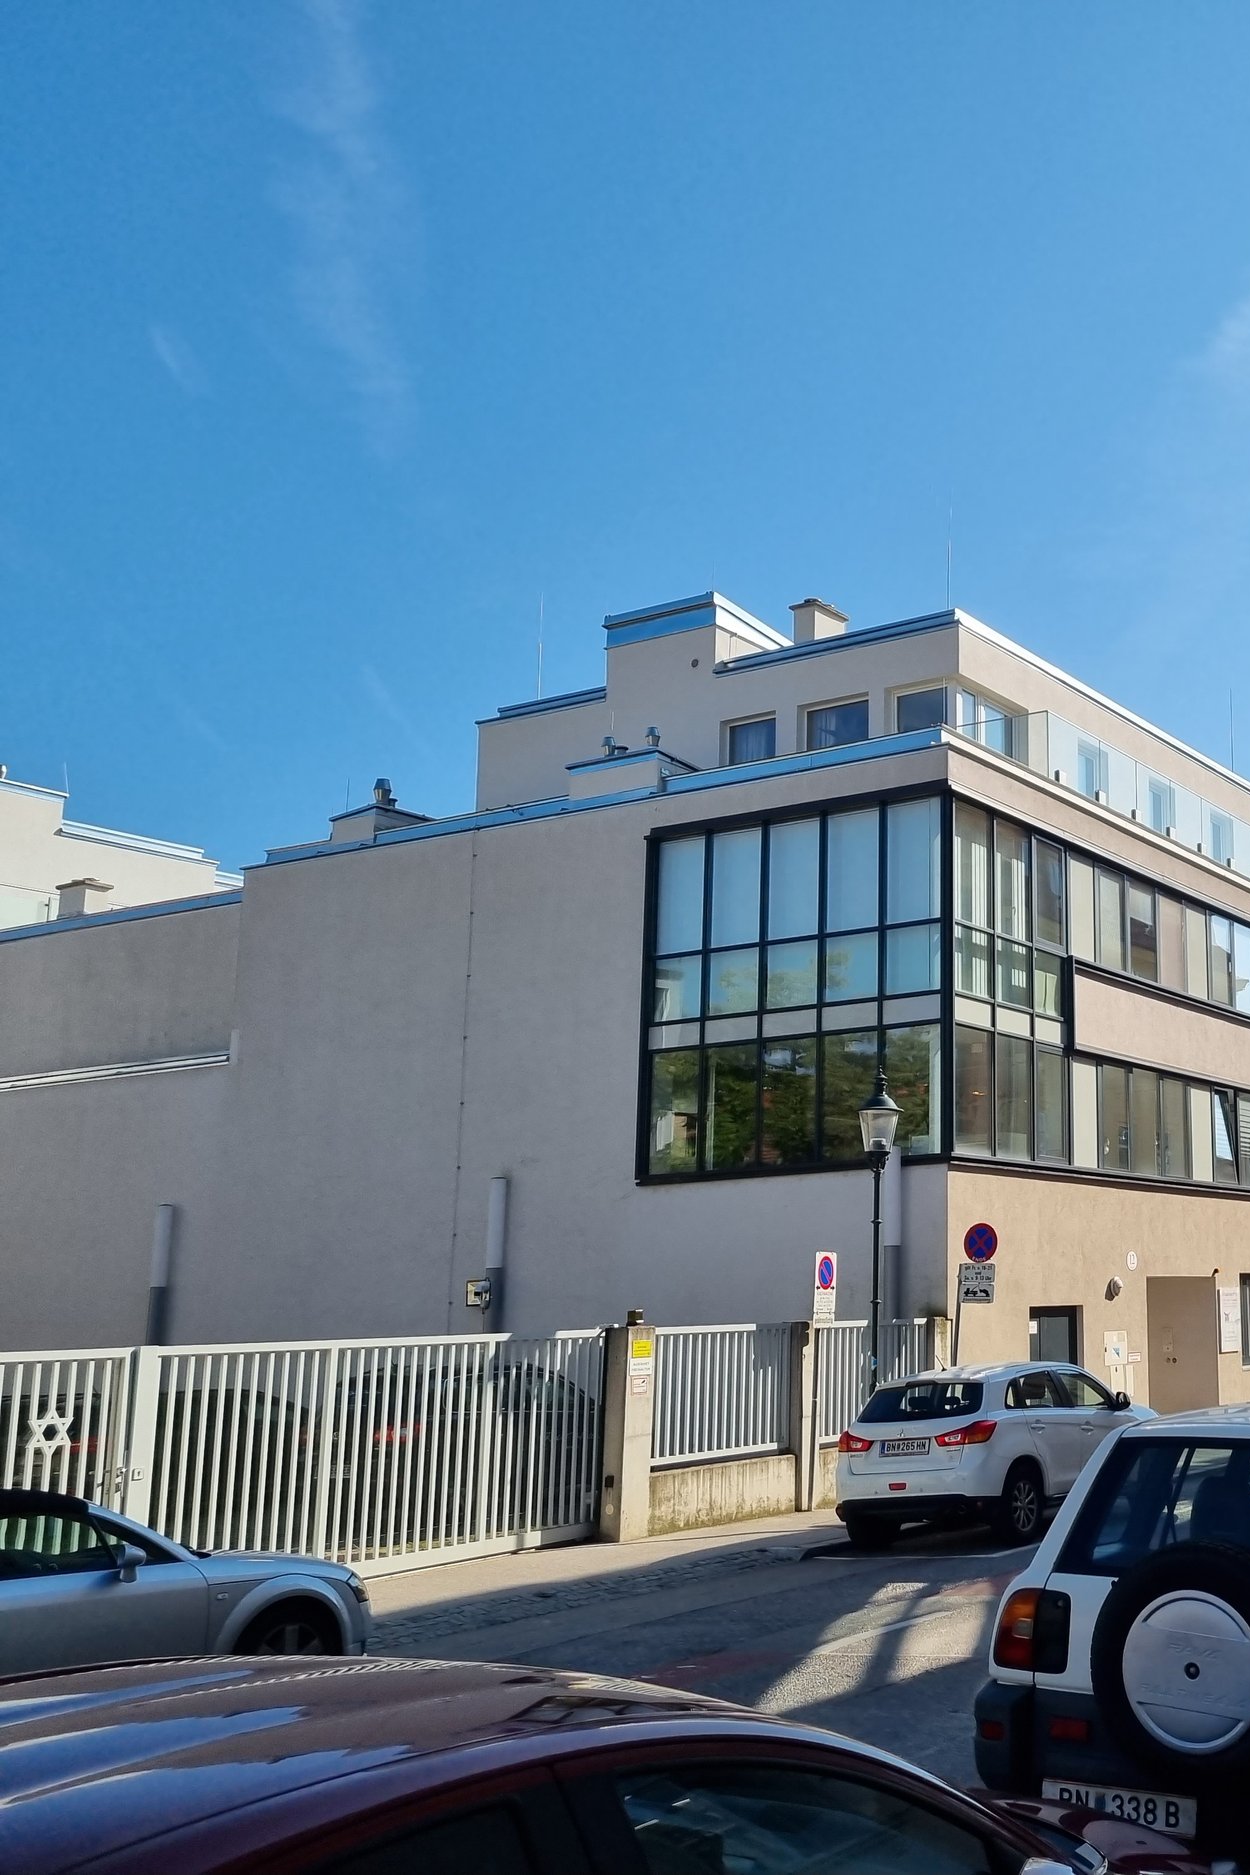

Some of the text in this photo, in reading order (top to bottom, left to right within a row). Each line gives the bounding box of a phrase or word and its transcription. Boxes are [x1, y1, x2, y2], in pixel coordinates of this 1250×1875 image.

[886, 1440, 926, 1452] BN 265 HN
[1111, 1794, 1158, 1826] 338
[1165, 1800, 1180, 1828] B
